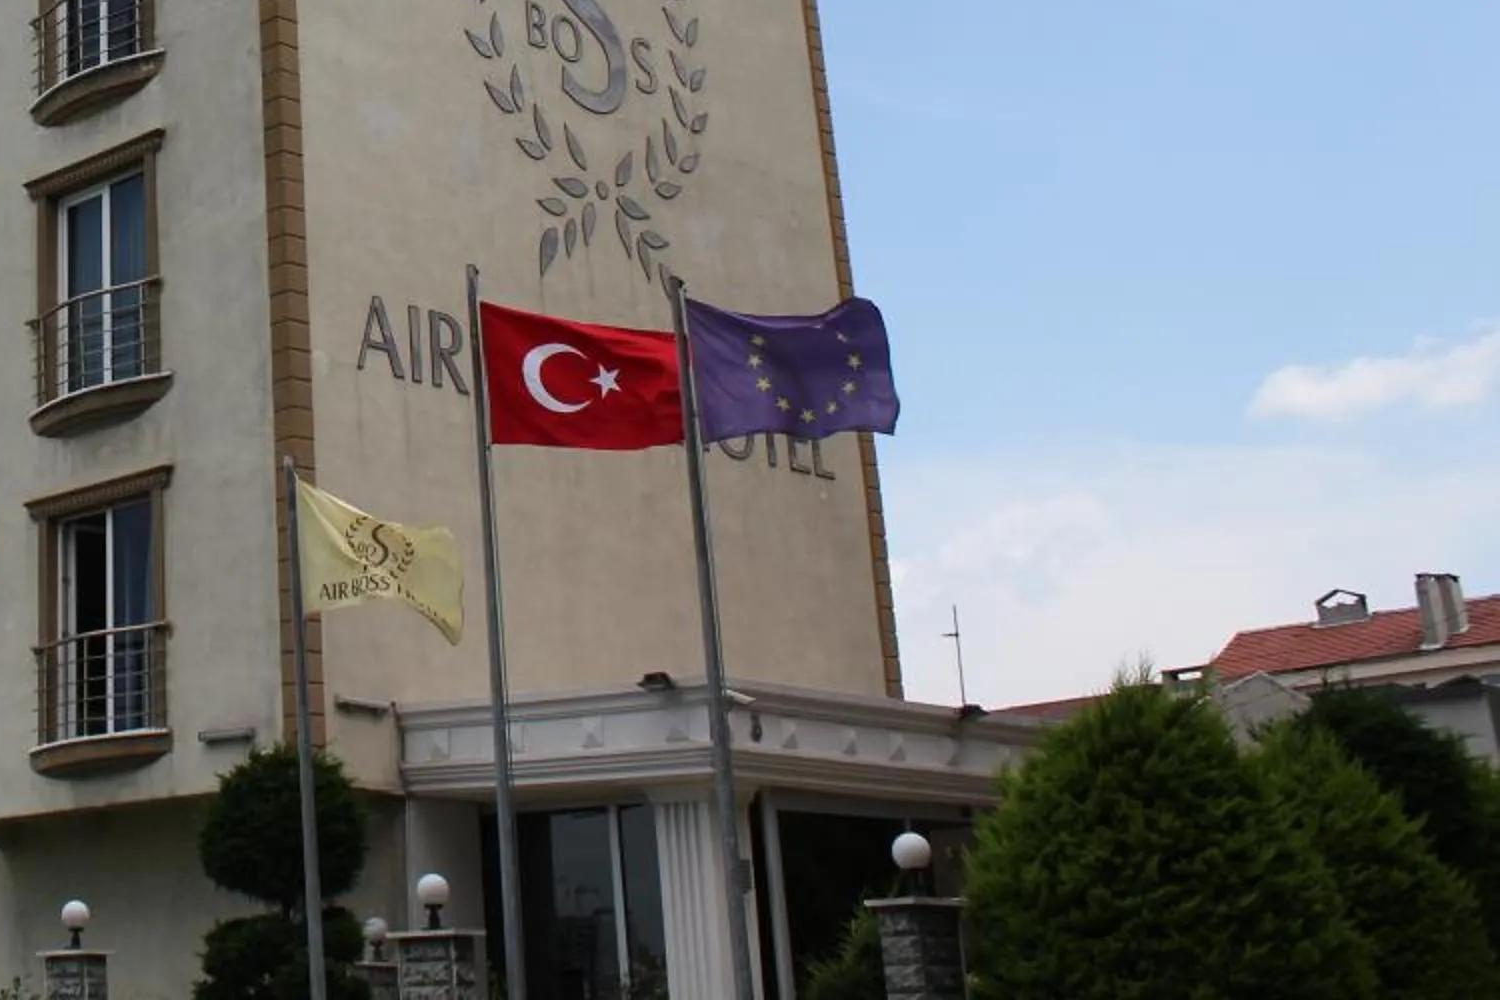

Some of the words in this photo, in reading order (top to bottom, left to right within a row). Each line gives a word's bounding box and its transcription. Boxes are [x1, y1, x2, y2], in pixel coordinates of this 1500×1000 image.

[357, 295, 470, 395] AIR
[320, 581, 349, 601] AIR
[351, 574, 390, 596] BOSS
